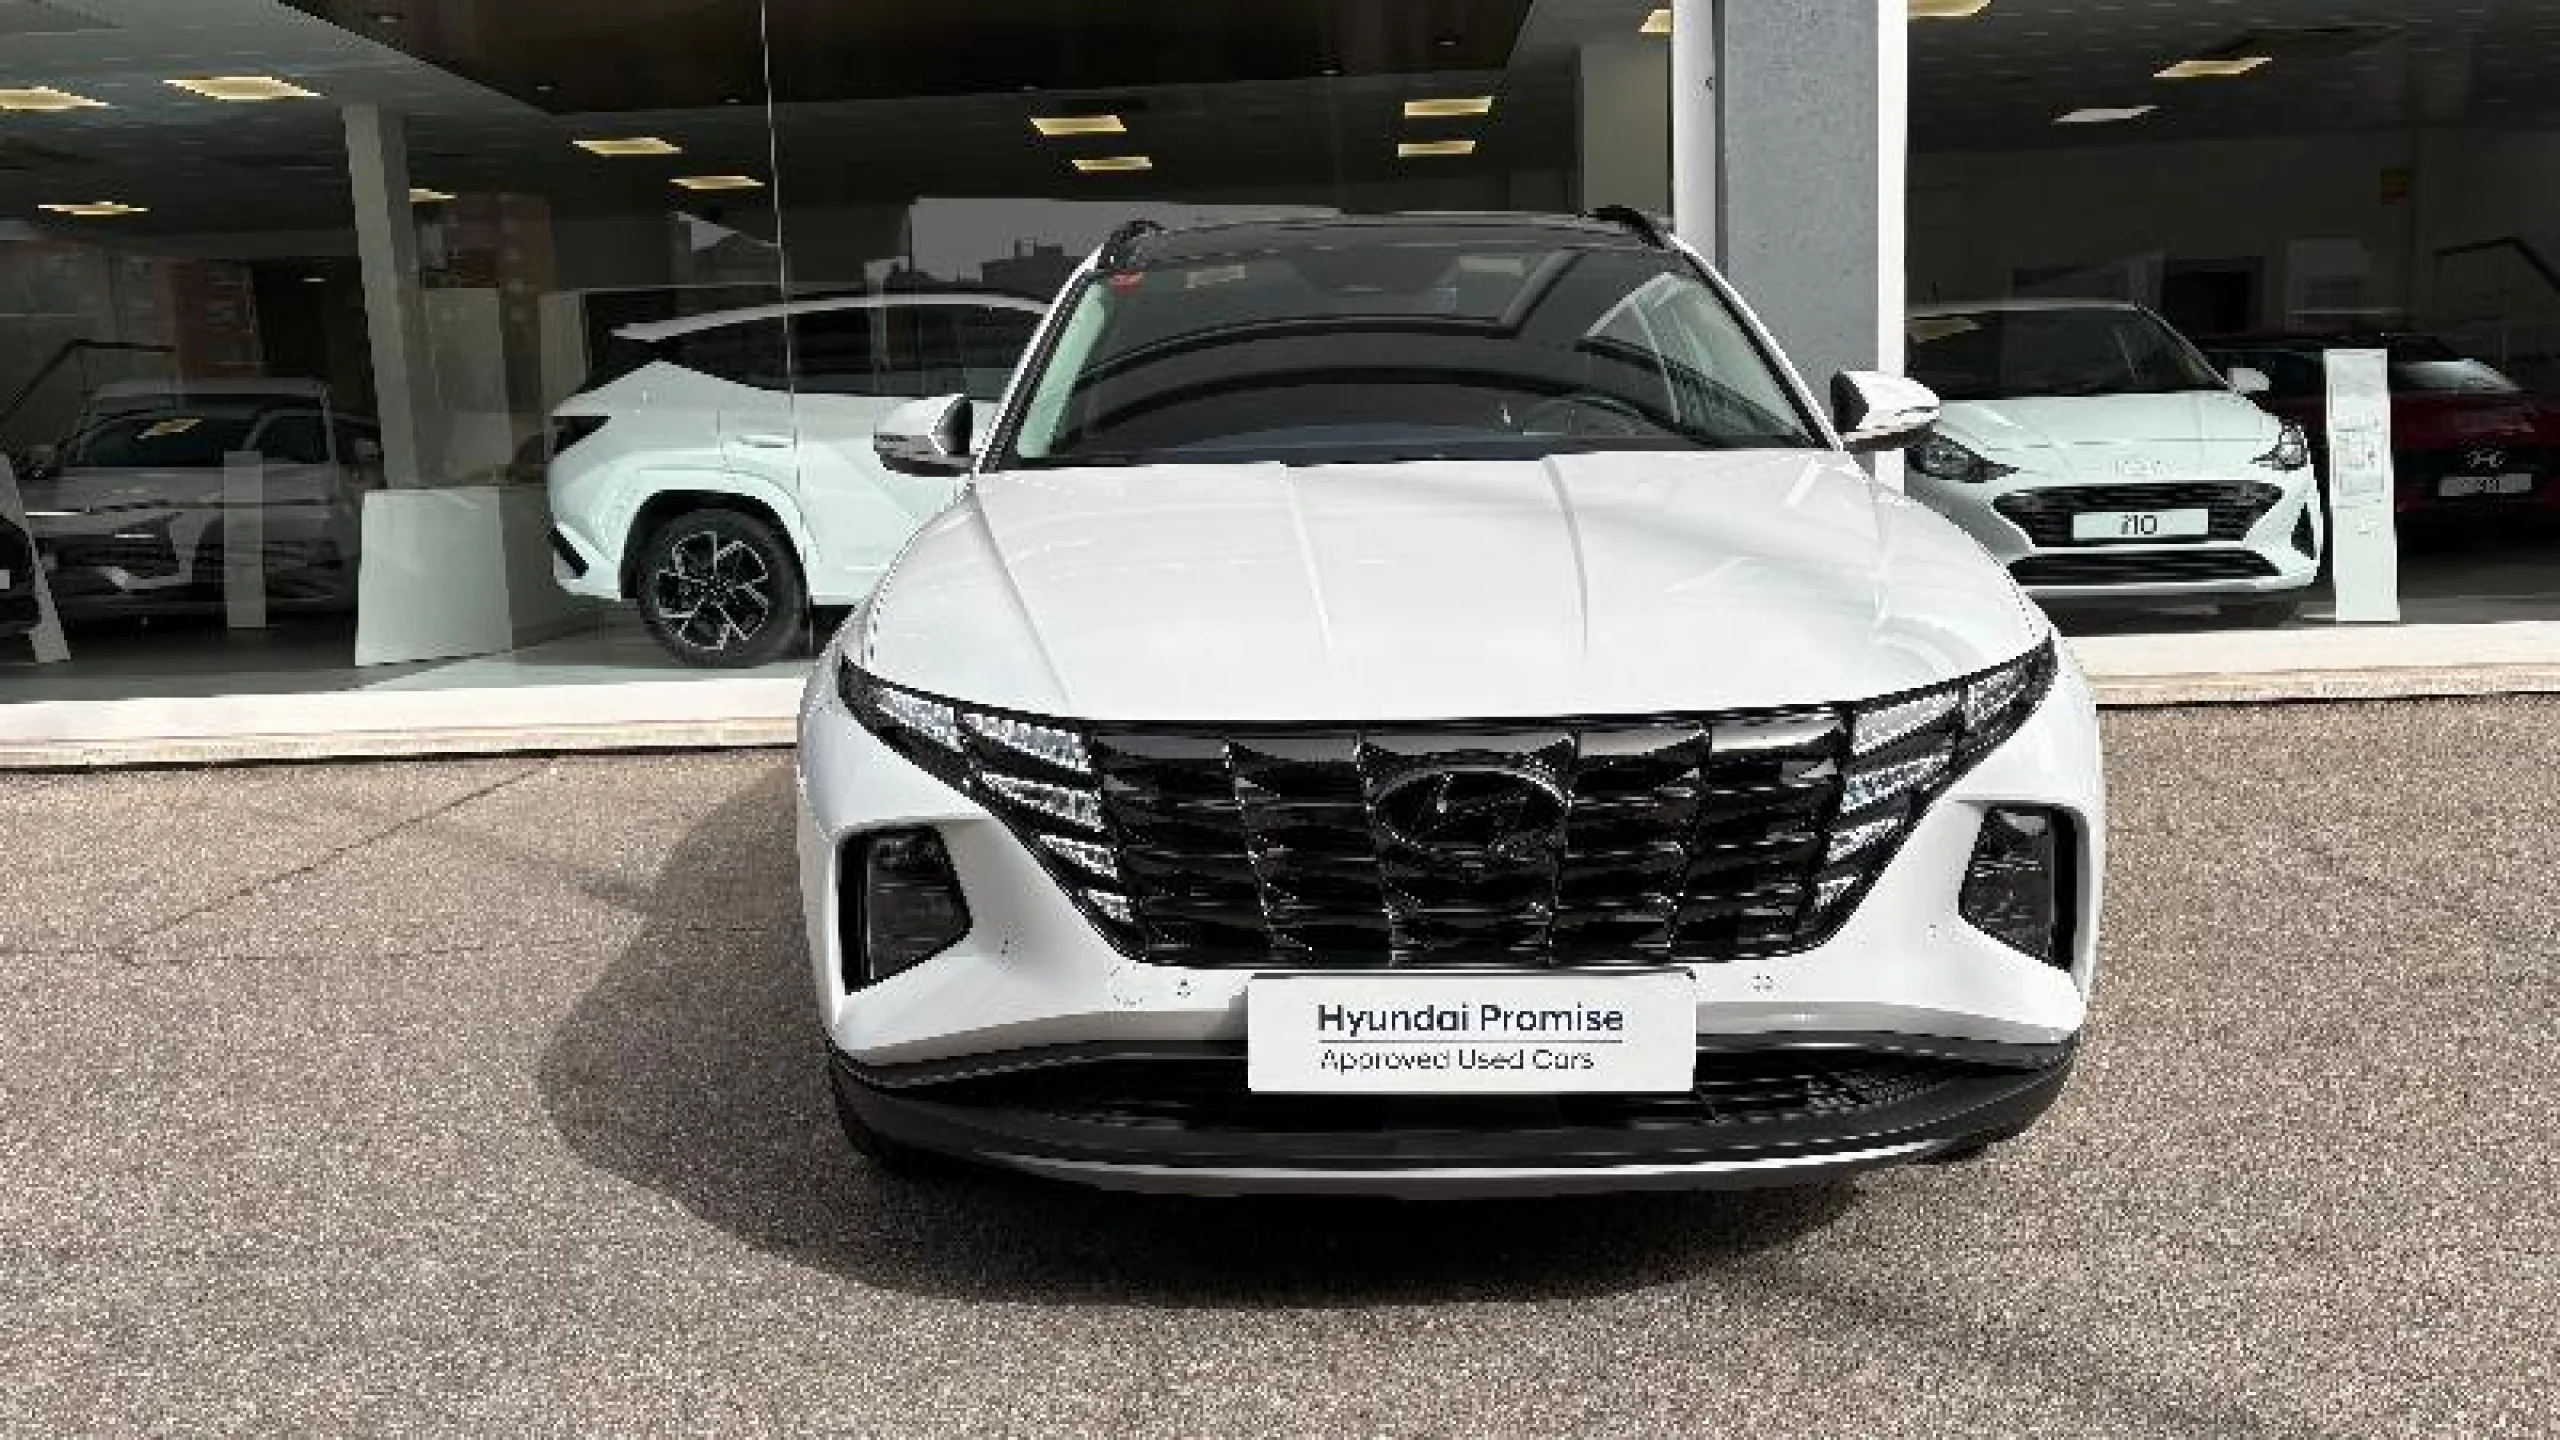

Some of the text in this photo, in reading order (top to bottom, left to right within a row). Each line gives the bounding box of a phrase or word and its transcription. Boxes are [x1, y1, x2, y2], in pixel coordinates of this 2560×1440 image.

[1317, 1001, 1624, 1038] Hyundai Promise
[1320, 1049, 1595, 1076] Approved Used Cars
